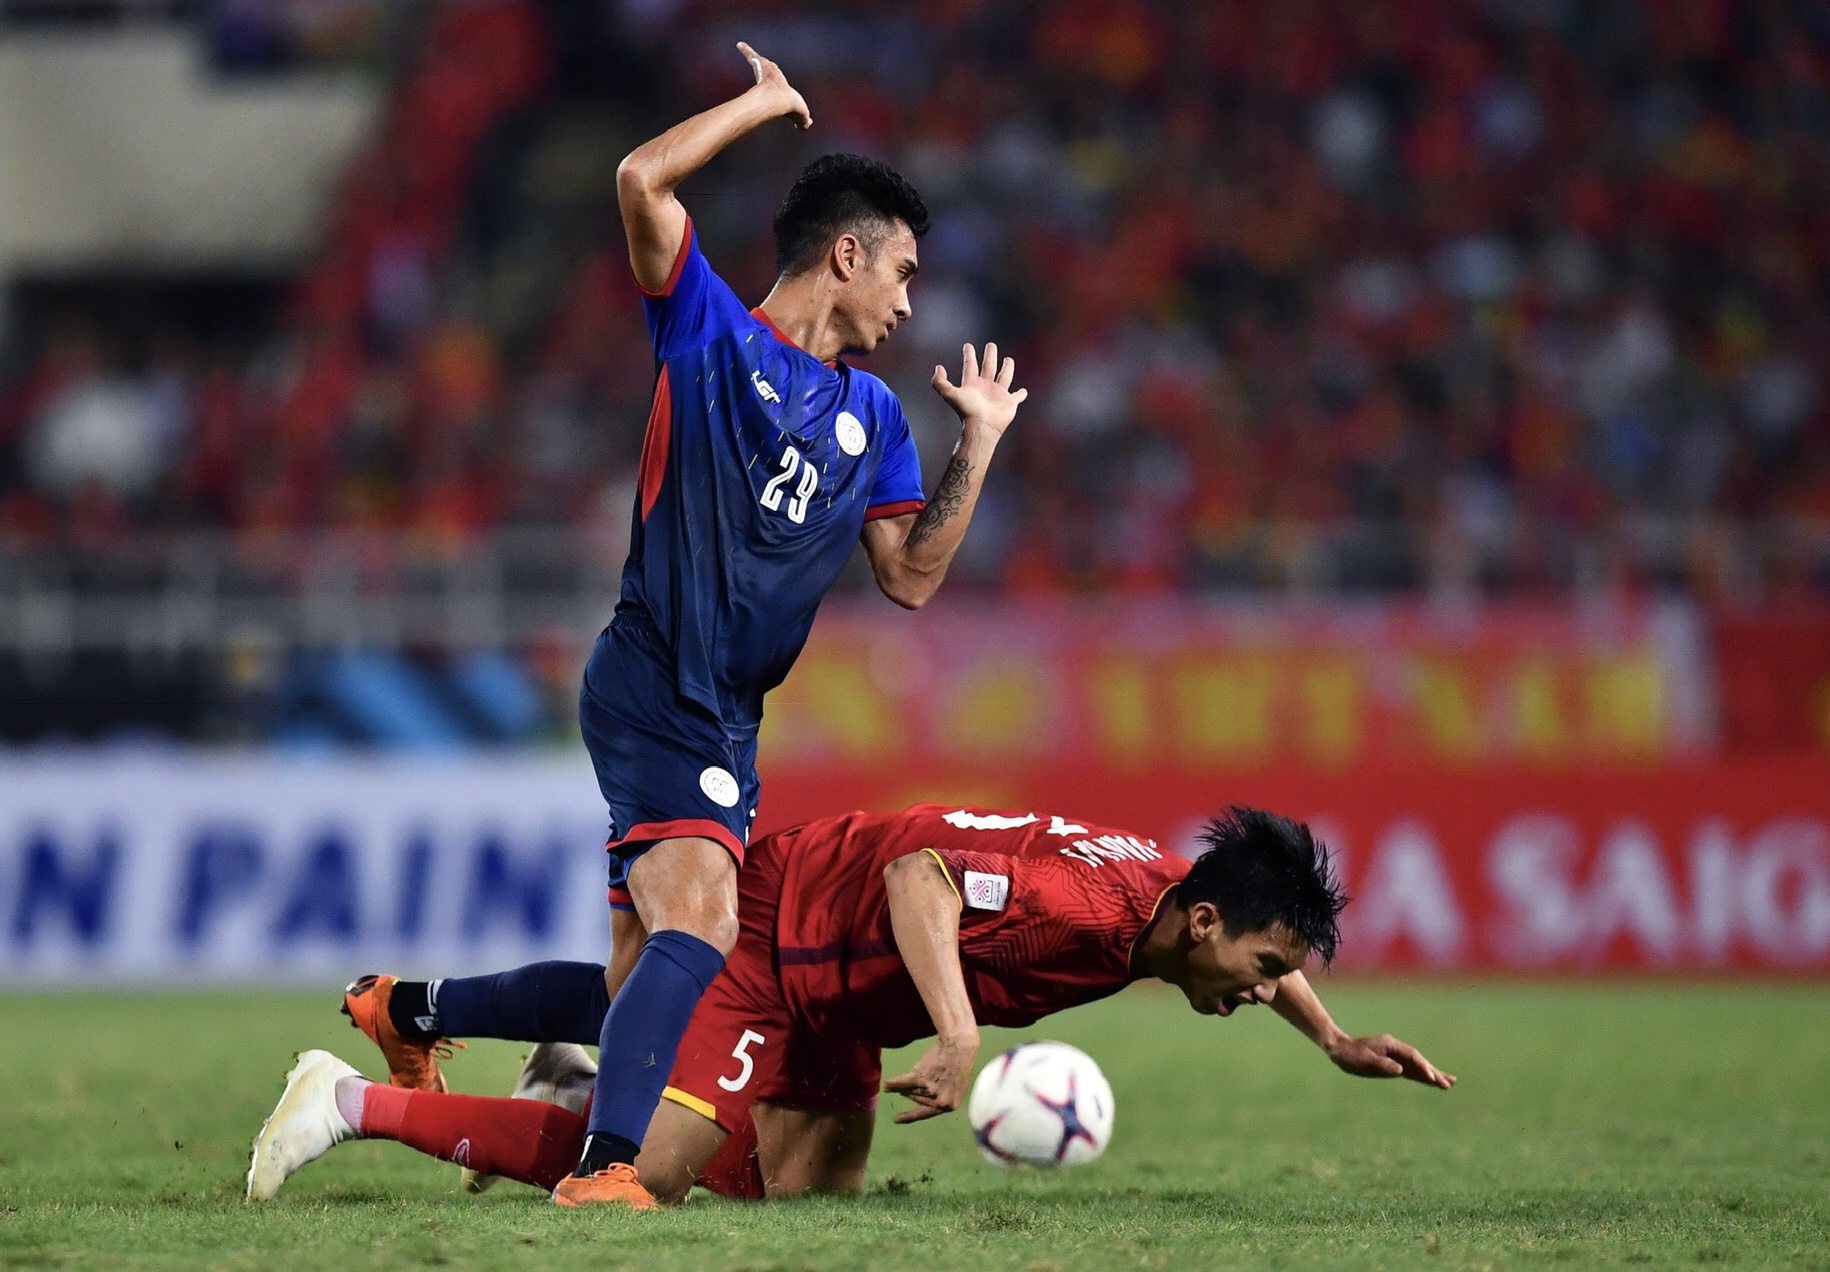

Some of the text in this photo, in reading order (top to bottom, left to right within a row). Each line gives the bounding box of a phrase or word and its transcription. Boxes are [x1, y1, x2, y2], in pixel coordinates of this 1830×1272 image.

[760, 445, 818, 524] 29
[0, 820, 600, 946] N PAIN
[717, 1029, 765, 1092] 5
